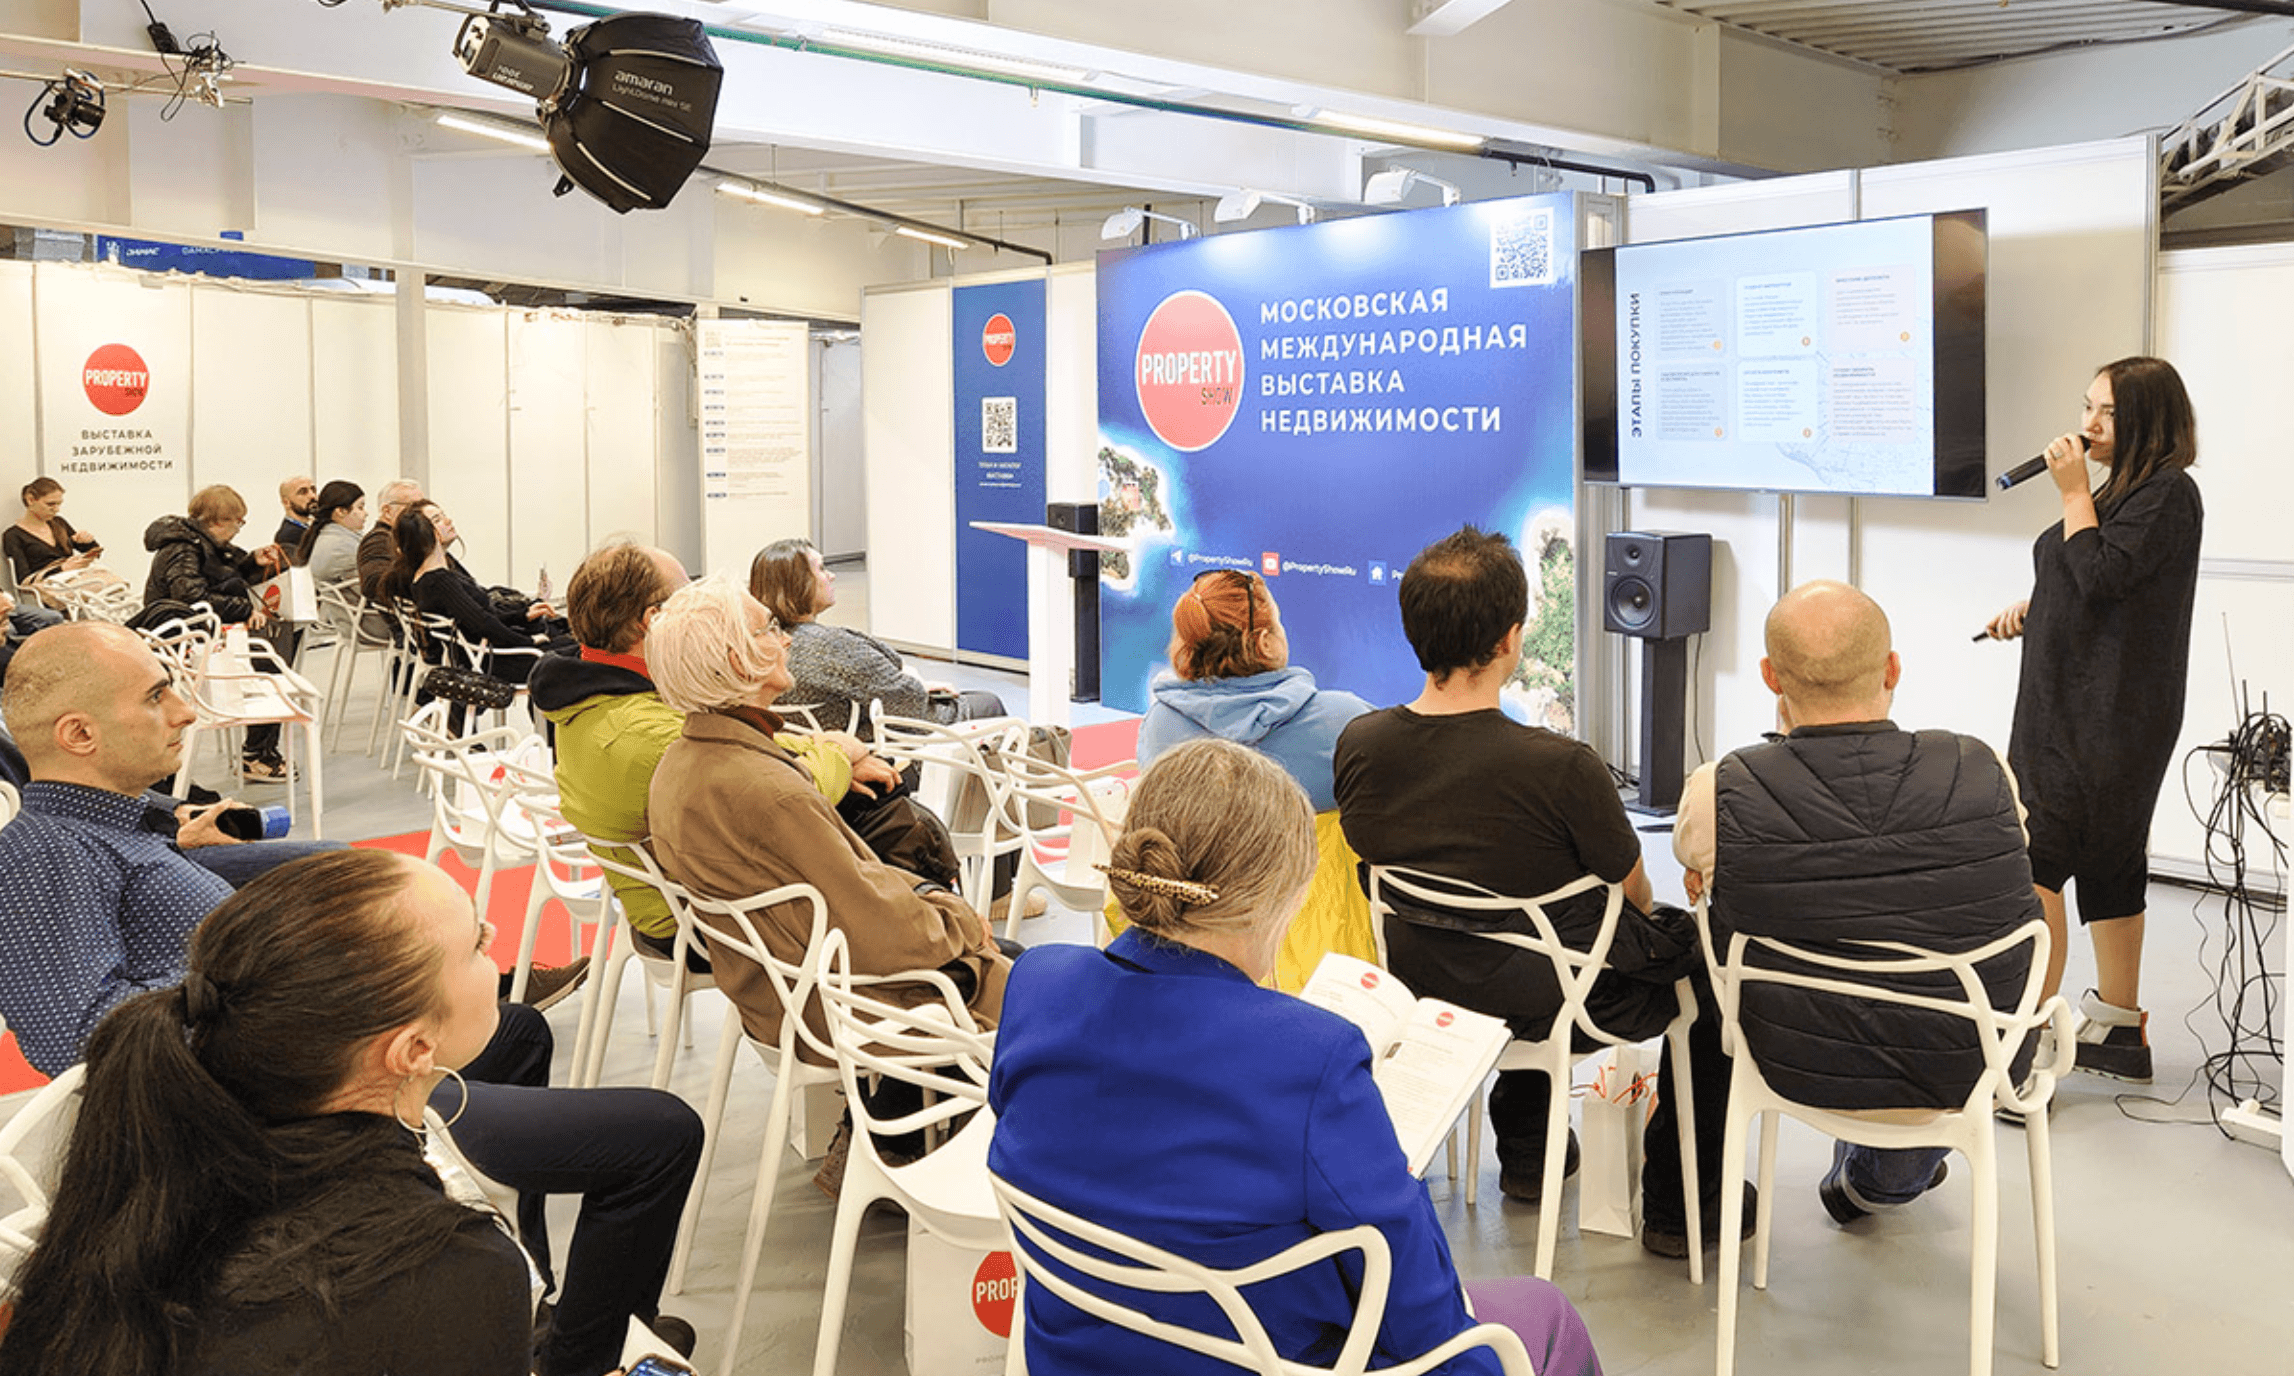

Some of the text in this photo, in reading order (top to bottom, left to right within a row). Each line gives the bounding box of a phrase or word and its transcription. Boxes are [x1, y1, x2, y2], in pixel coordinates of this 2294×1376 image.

[614, 70, 673, 96] amaran
[1260, 287, 1449, 325] МОСКОВСКАЯ
[1260, 324, 1527, 362] МЕЖДУНАРОДНАЯ
[85, 369, 148, 387] PROPERTY
[1142, 350, 1237, 386] PROPERTY
[1630, 293, 1642, 439] ЭТАПЫ ПОКУПКИ
[1201, 387, 1232, 405] SHOW
[1260, 369, 1405, 396] ВЫСТАВКА
[81, 429, 152, 440] ВЫСТАВКА
[1260, 406, 1500, 436] НЕДВИЖИМОСТИ
[71, 443, 162, 458] ЗАРУБЕЖНОЙ
[60, 460, 174, 474] НЕДВИЖИМОСТИ
[976, 1276, 1018, 1304] PROP
